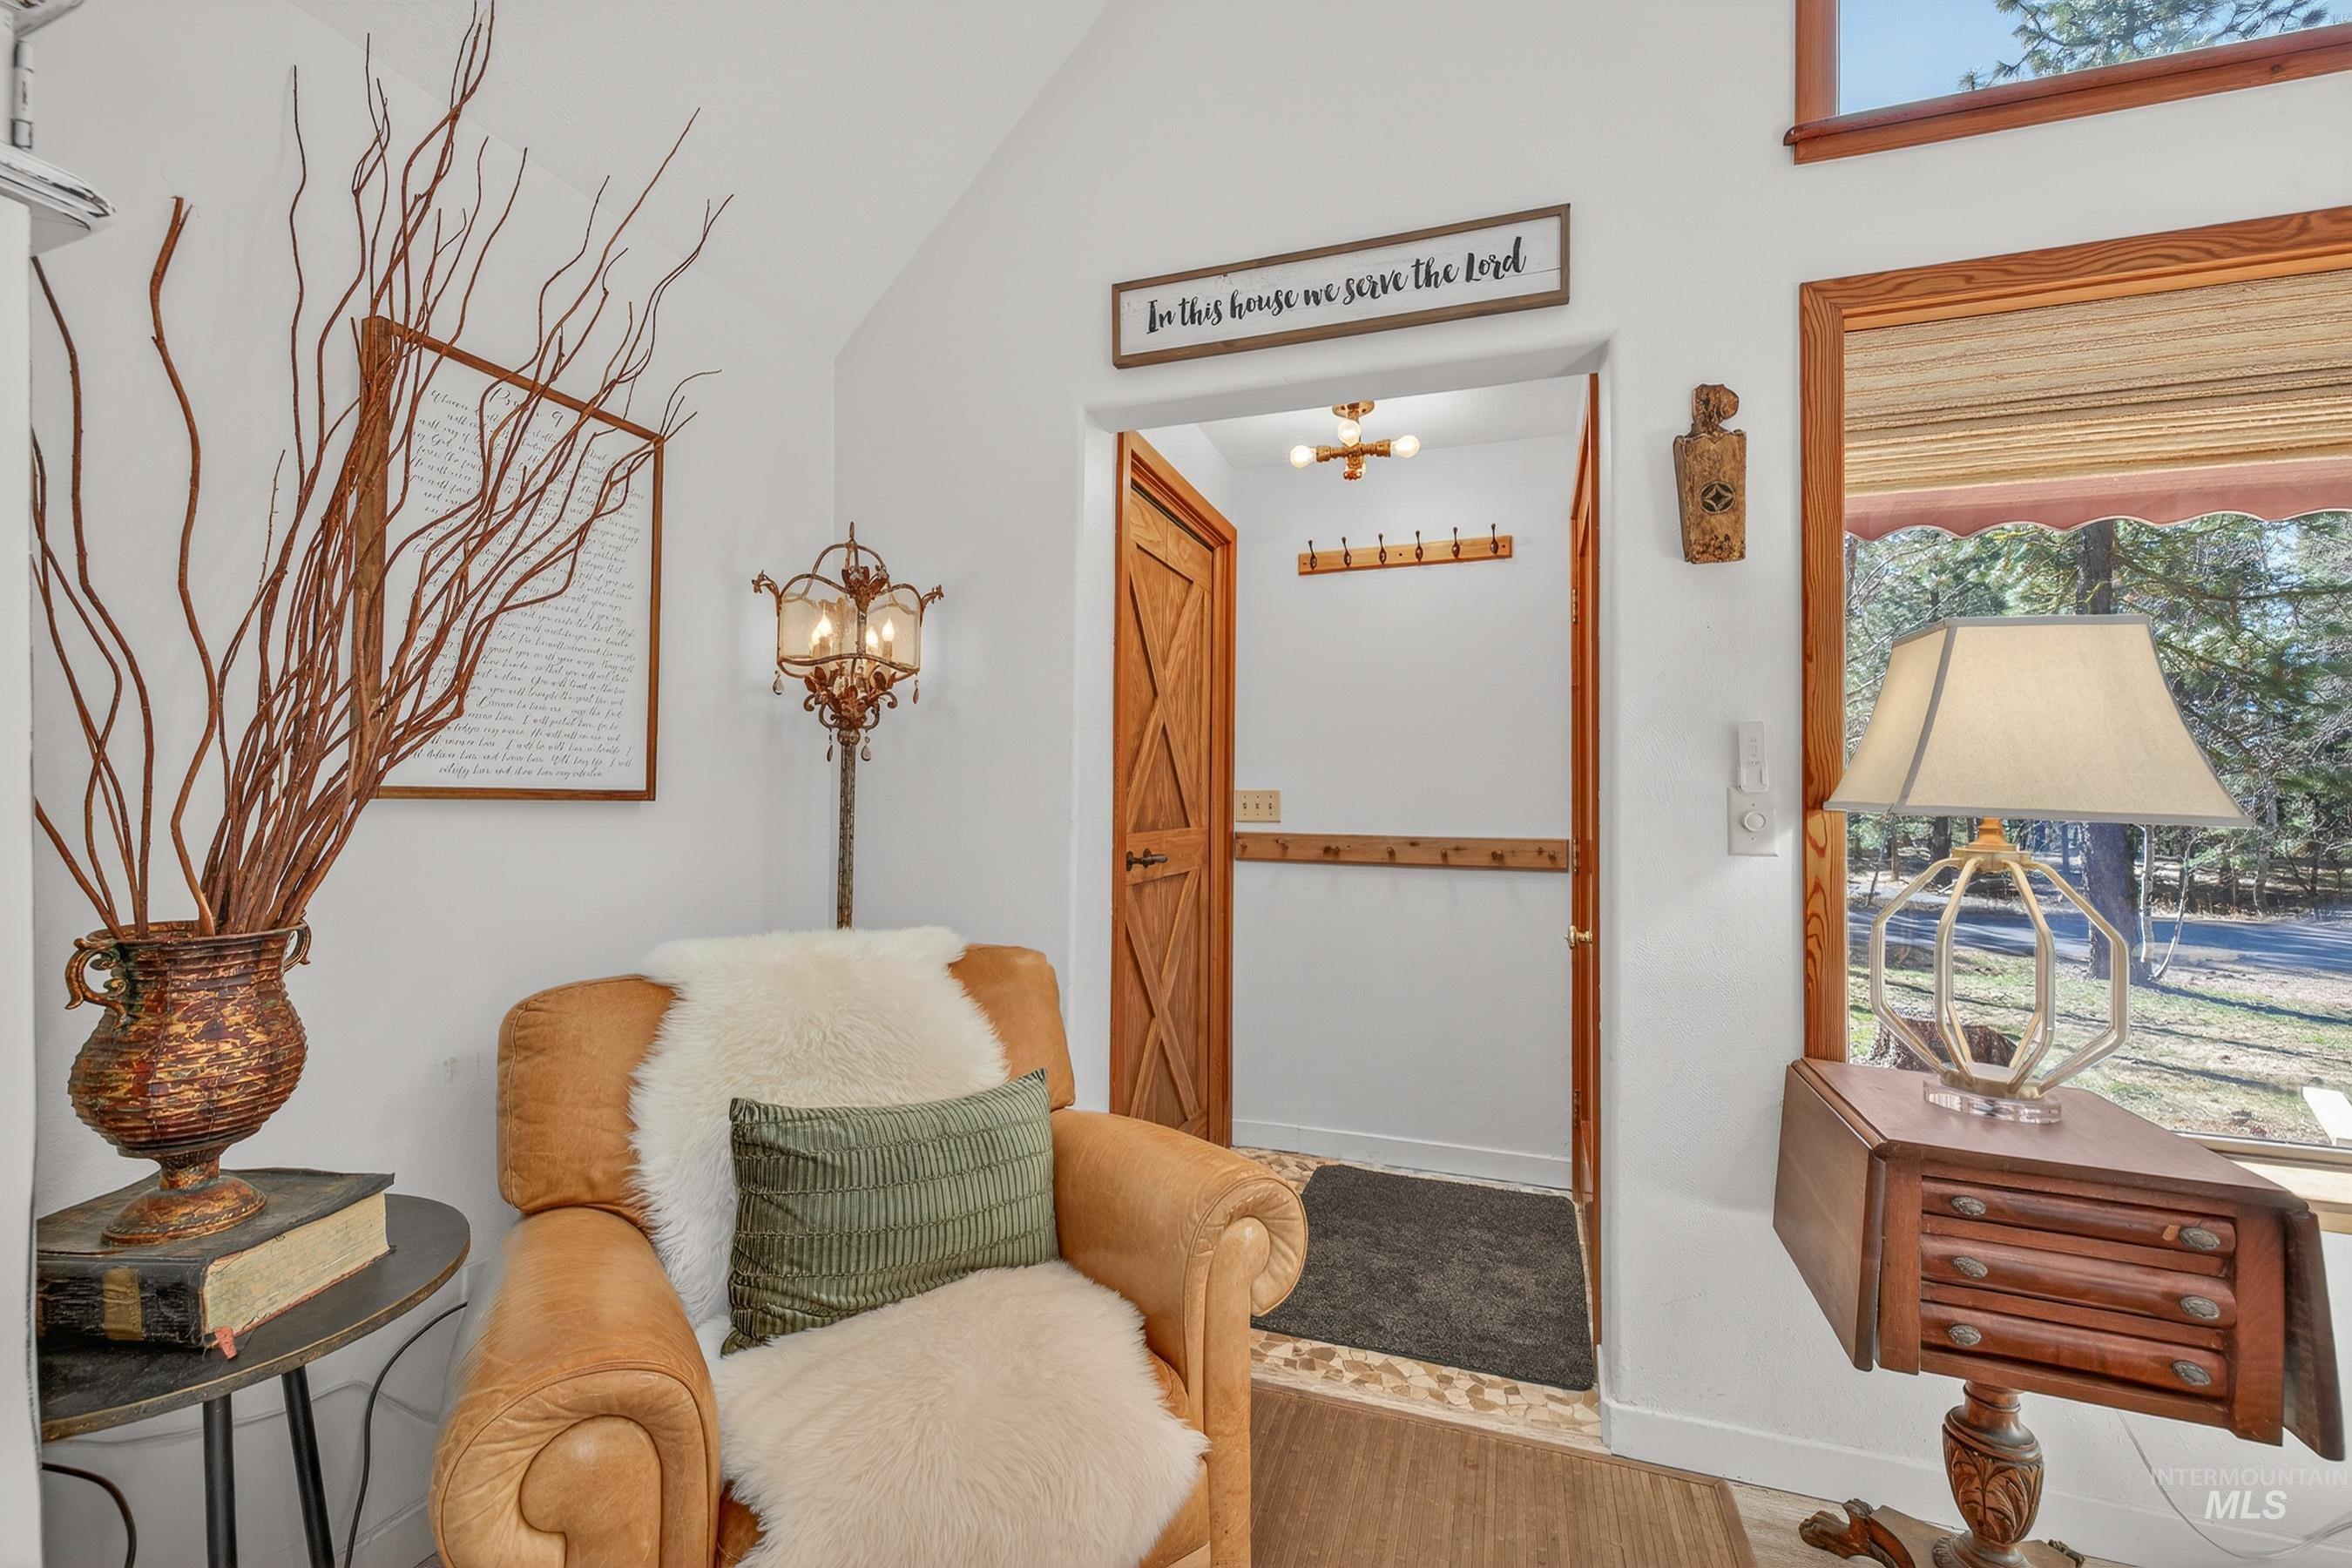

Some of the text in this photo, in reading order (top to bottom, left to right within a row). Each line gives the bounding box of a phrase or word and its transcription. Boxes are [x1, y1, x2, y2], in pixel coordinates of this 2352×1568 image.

[1146, 236, 1528, 334] In this house we serve the Lord
